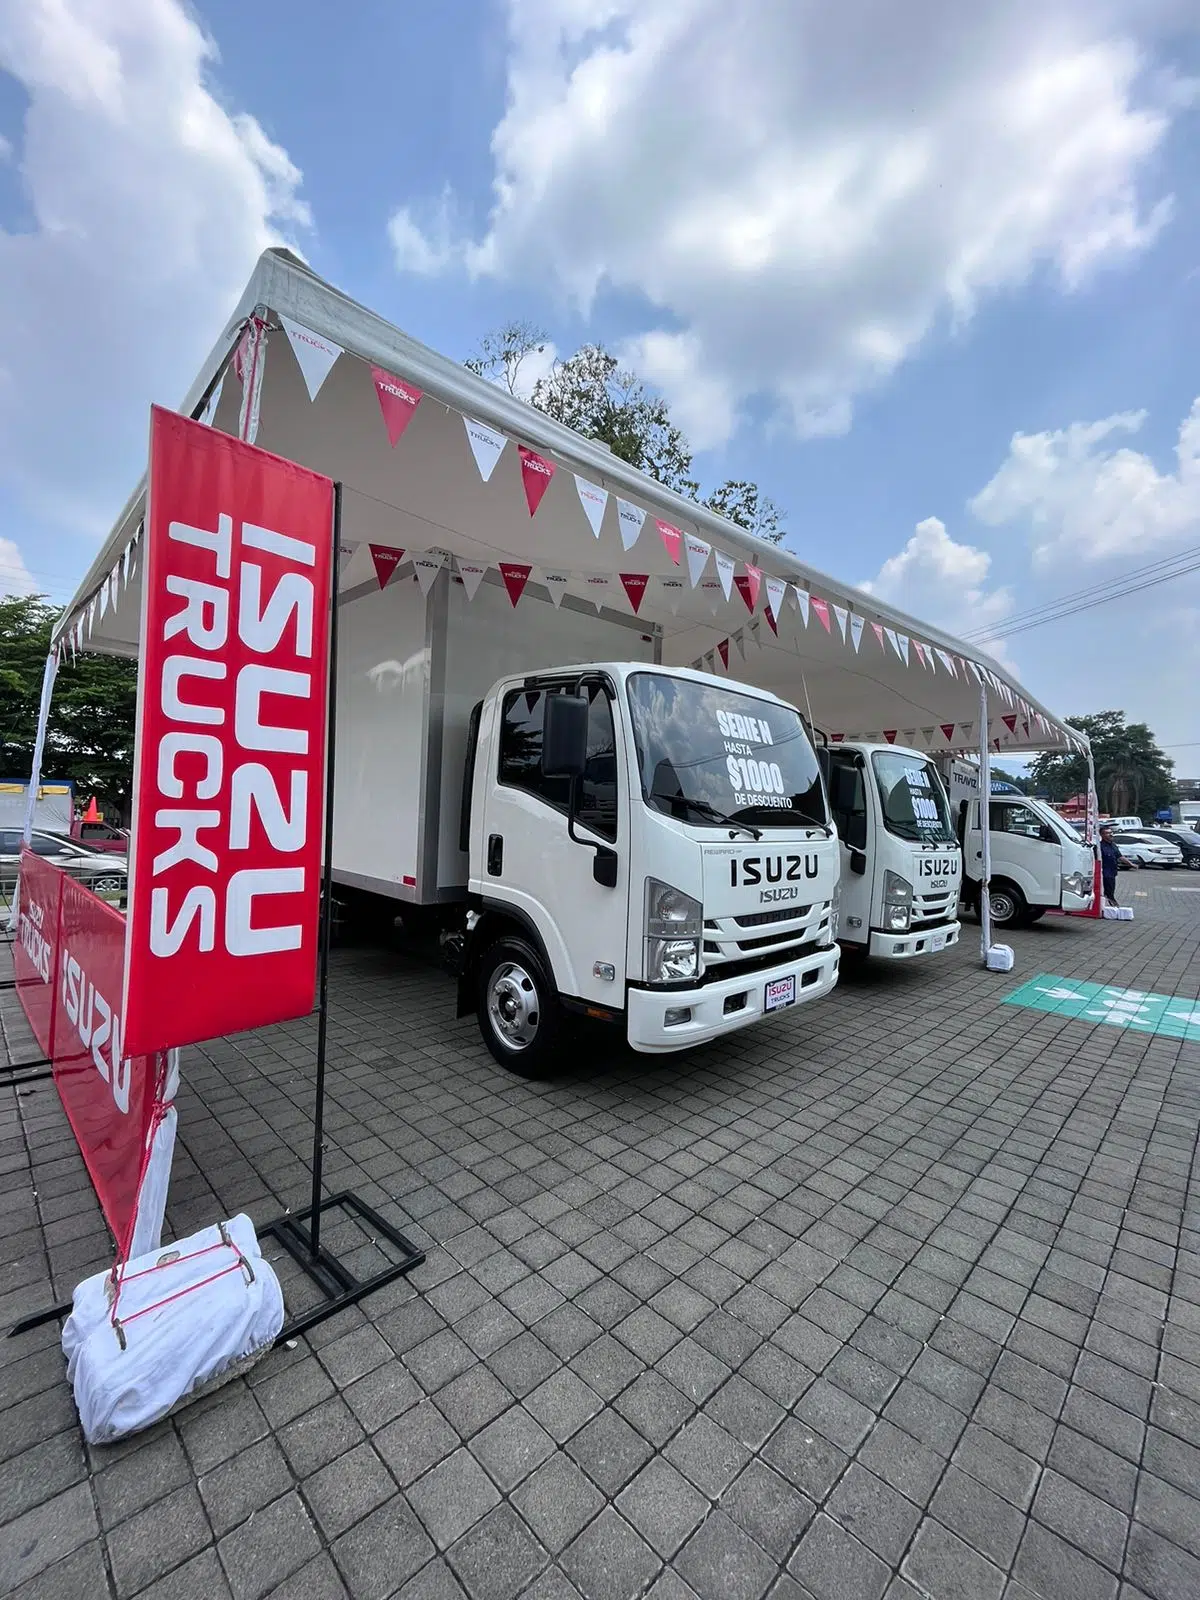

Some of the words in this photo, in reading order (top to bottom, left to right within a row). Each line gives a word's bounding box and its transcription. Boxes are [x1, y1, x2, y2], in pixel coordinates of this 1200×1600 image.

[290, 330, 335, 356] TRUCKS
[378, 381, 416, 405] TRUCKS
[469, 430, 501, 449] TRUCKS
[523, 459, 551, 476] TRUCKS
[620, 512, 641, 525] TRUCKS
[150, 511, 233, 958] TRUCKS
[226, 521, 316, 957] ISUZU
[723, 740, 753, 756] HASTA
[726, 754, 785, 795] $1000
[734, 792, 747, 805] DE
[747, 793, 793, 809] DESCUENTO
[731, 854, 819, 887] ISUZU
[919, 859, 957, 876] ISUZU
[760, 886, 799, 904] ISUZU
[21, 912, 51, 984] TRUCKS
[768, 982, 792, 996] ISUZU
[62, 949, 131, 1114] ISUZU
